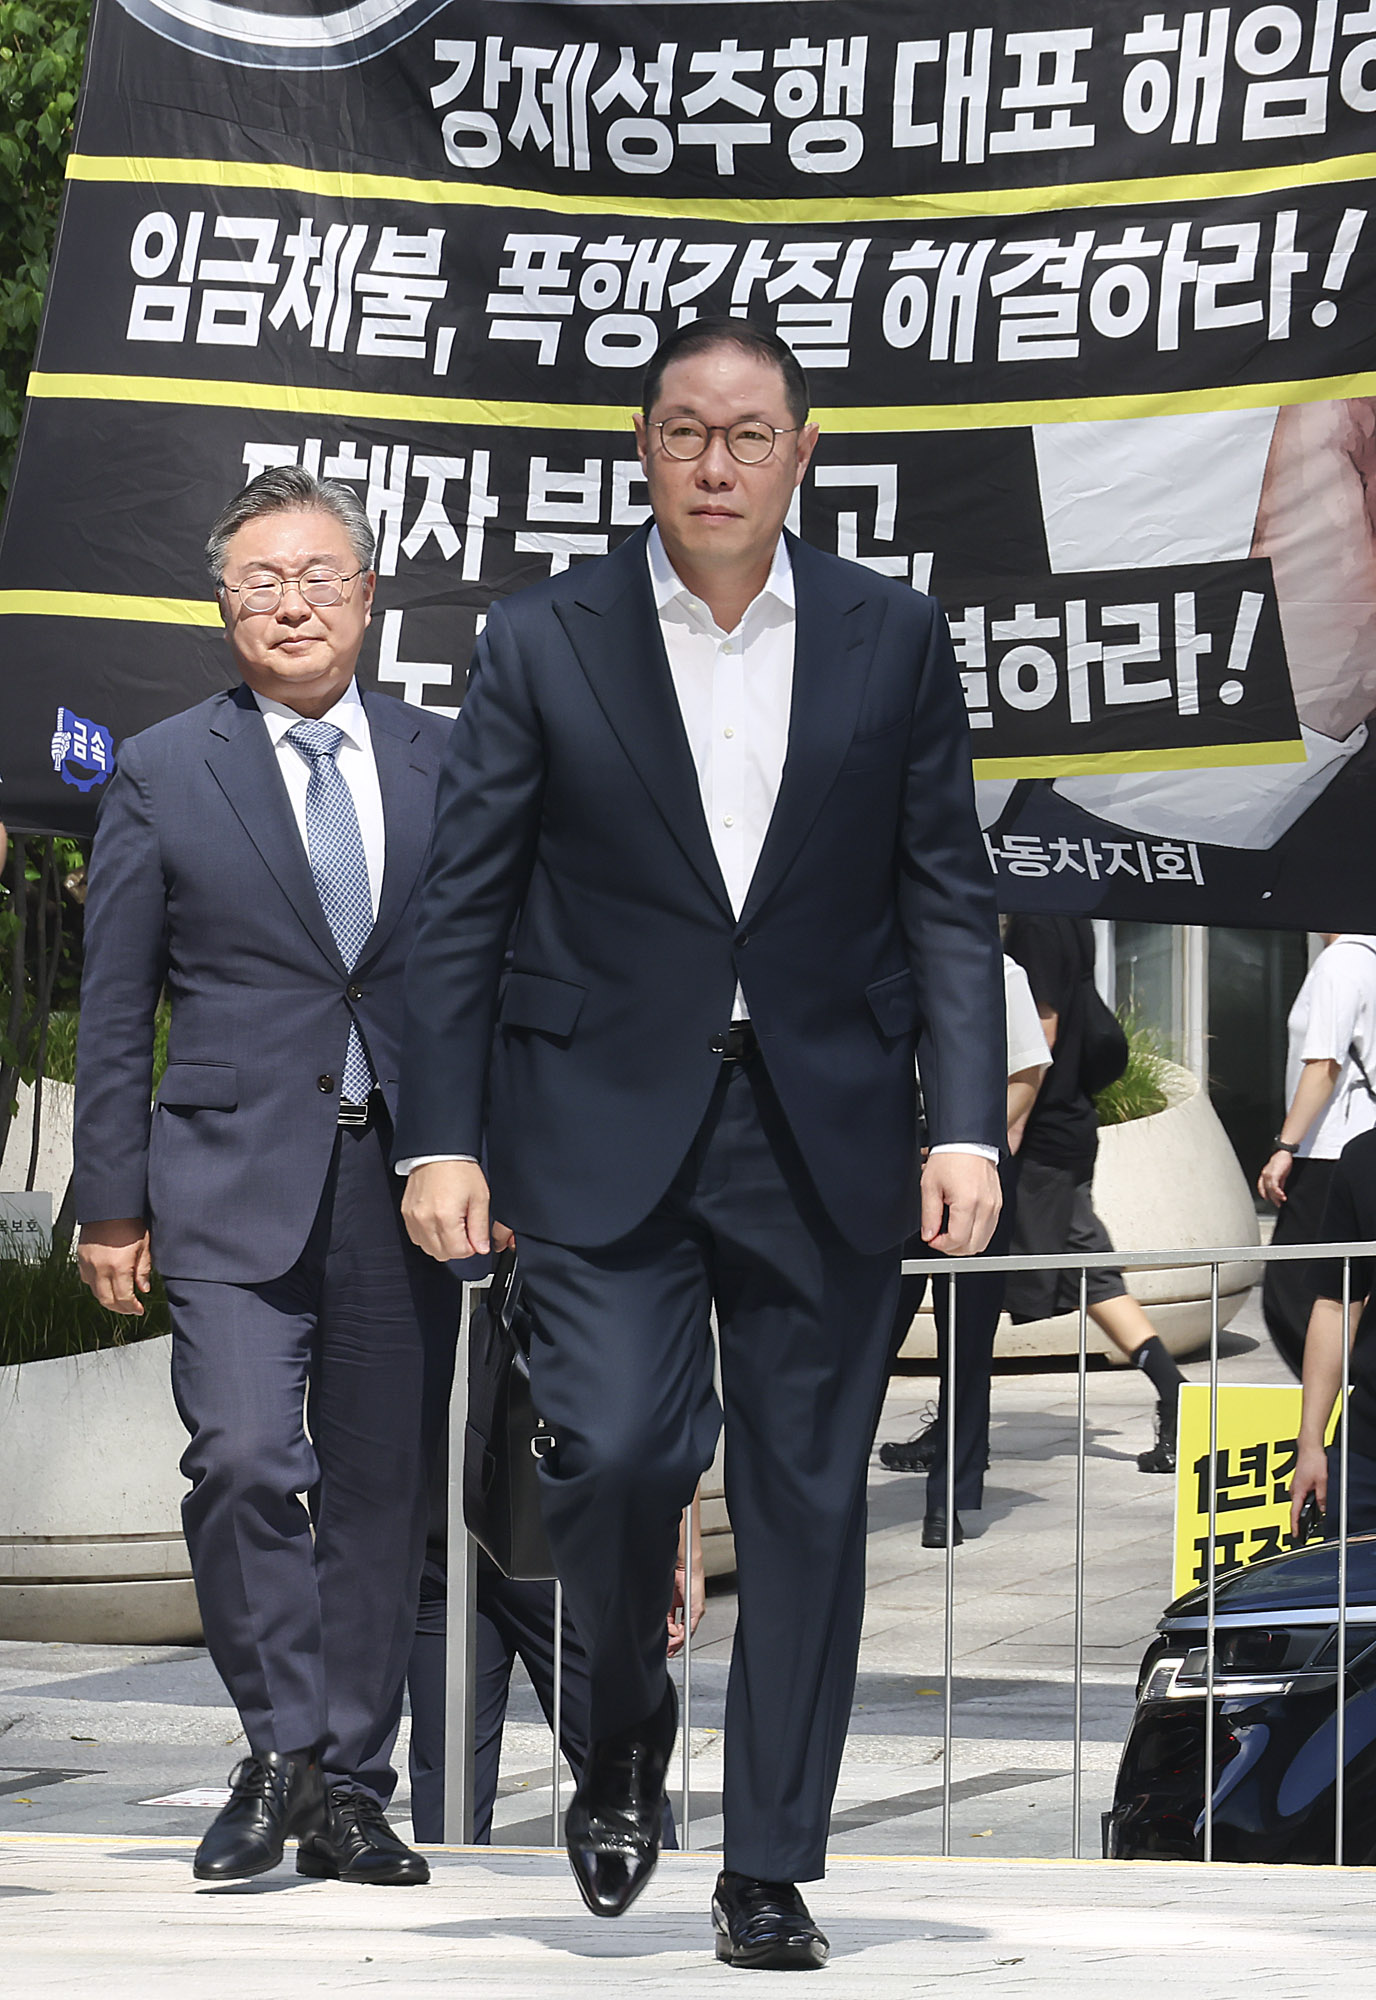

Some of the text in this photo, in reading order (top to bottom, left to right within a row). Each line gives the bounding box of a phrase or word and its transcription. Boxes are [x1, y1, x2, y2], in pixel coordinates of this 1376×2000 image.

[430, 36, 869, 175] 강제성추행
[892, 28, 1096, 164] 대표
[126, 211, 457, 376] 임금체불,
[882, 208, 1368, 363] 해결하라!
[73, 720, 106, 771] 금속
